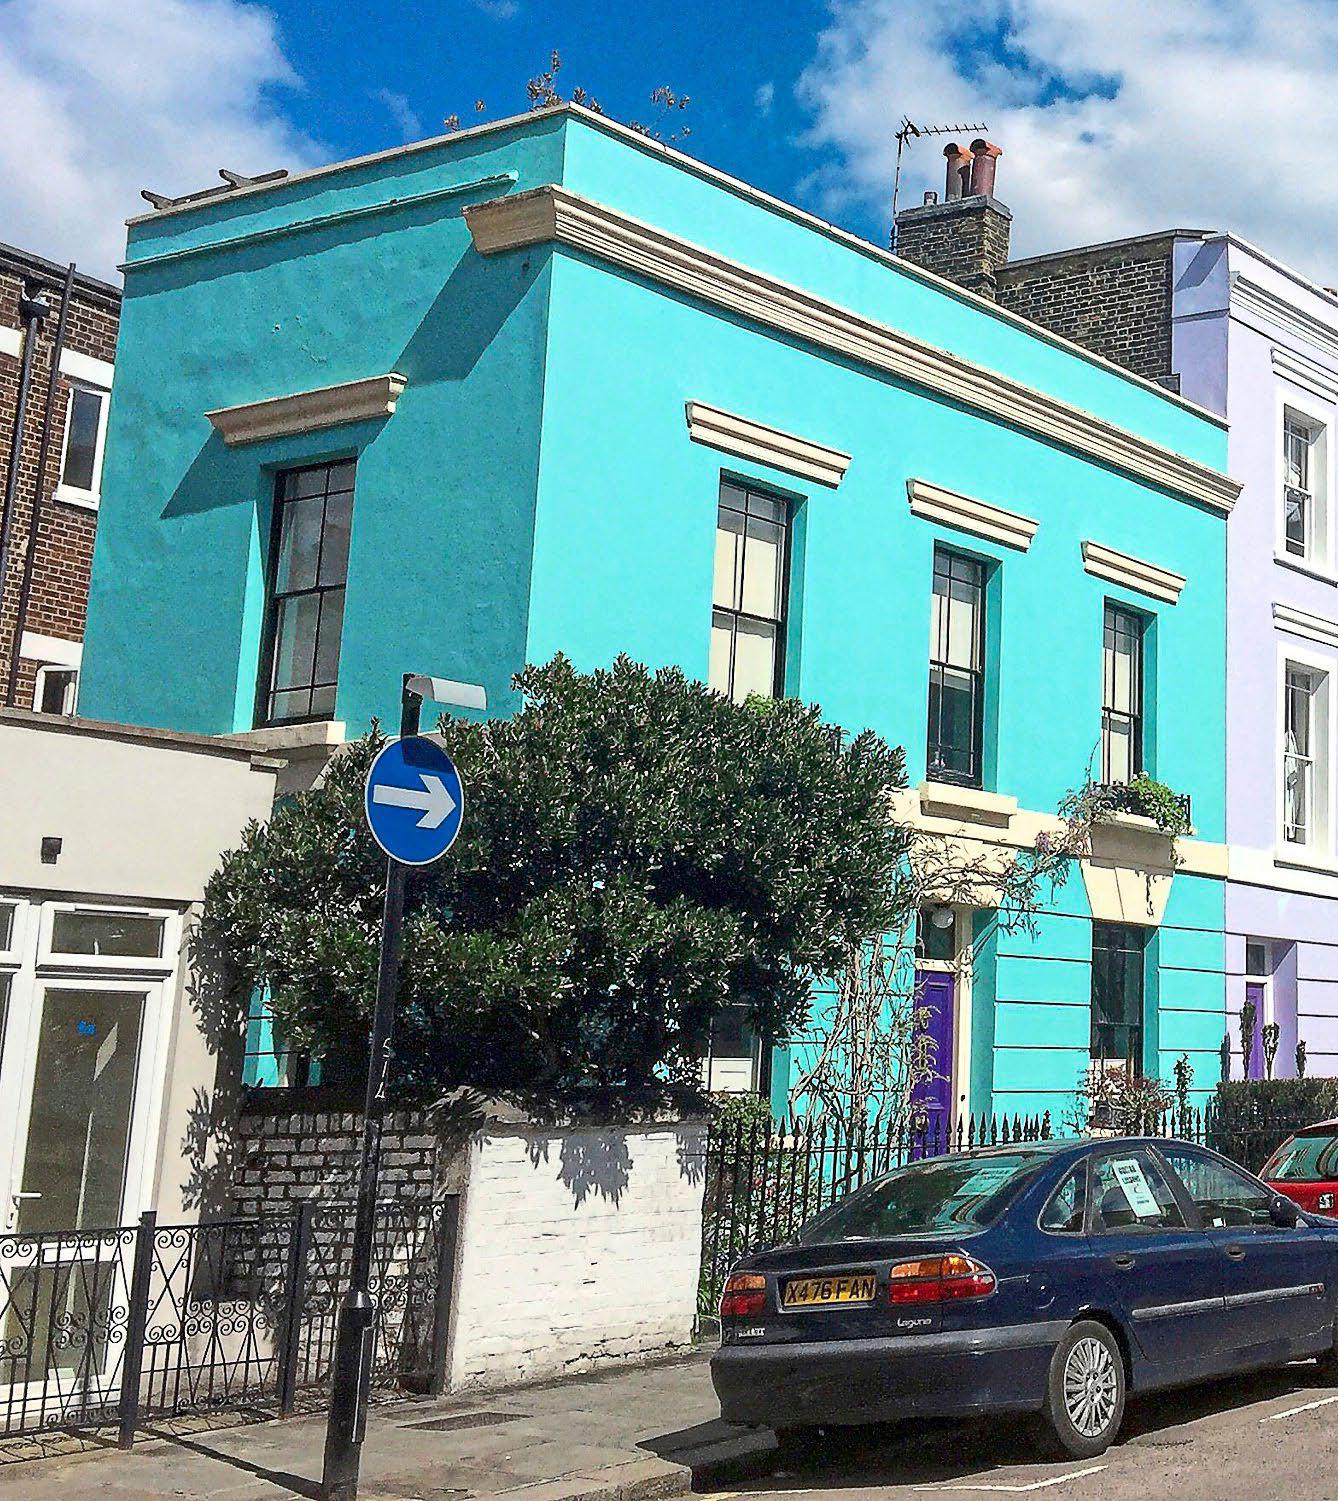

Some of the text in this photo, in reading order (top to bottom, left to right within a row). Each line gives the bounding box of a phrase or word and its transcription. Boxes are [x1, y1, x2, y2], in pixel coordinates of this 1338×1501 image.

[786, 1279, 875, 1303] X476 FAN
[897, 1318, 932, 1329] Laguna
